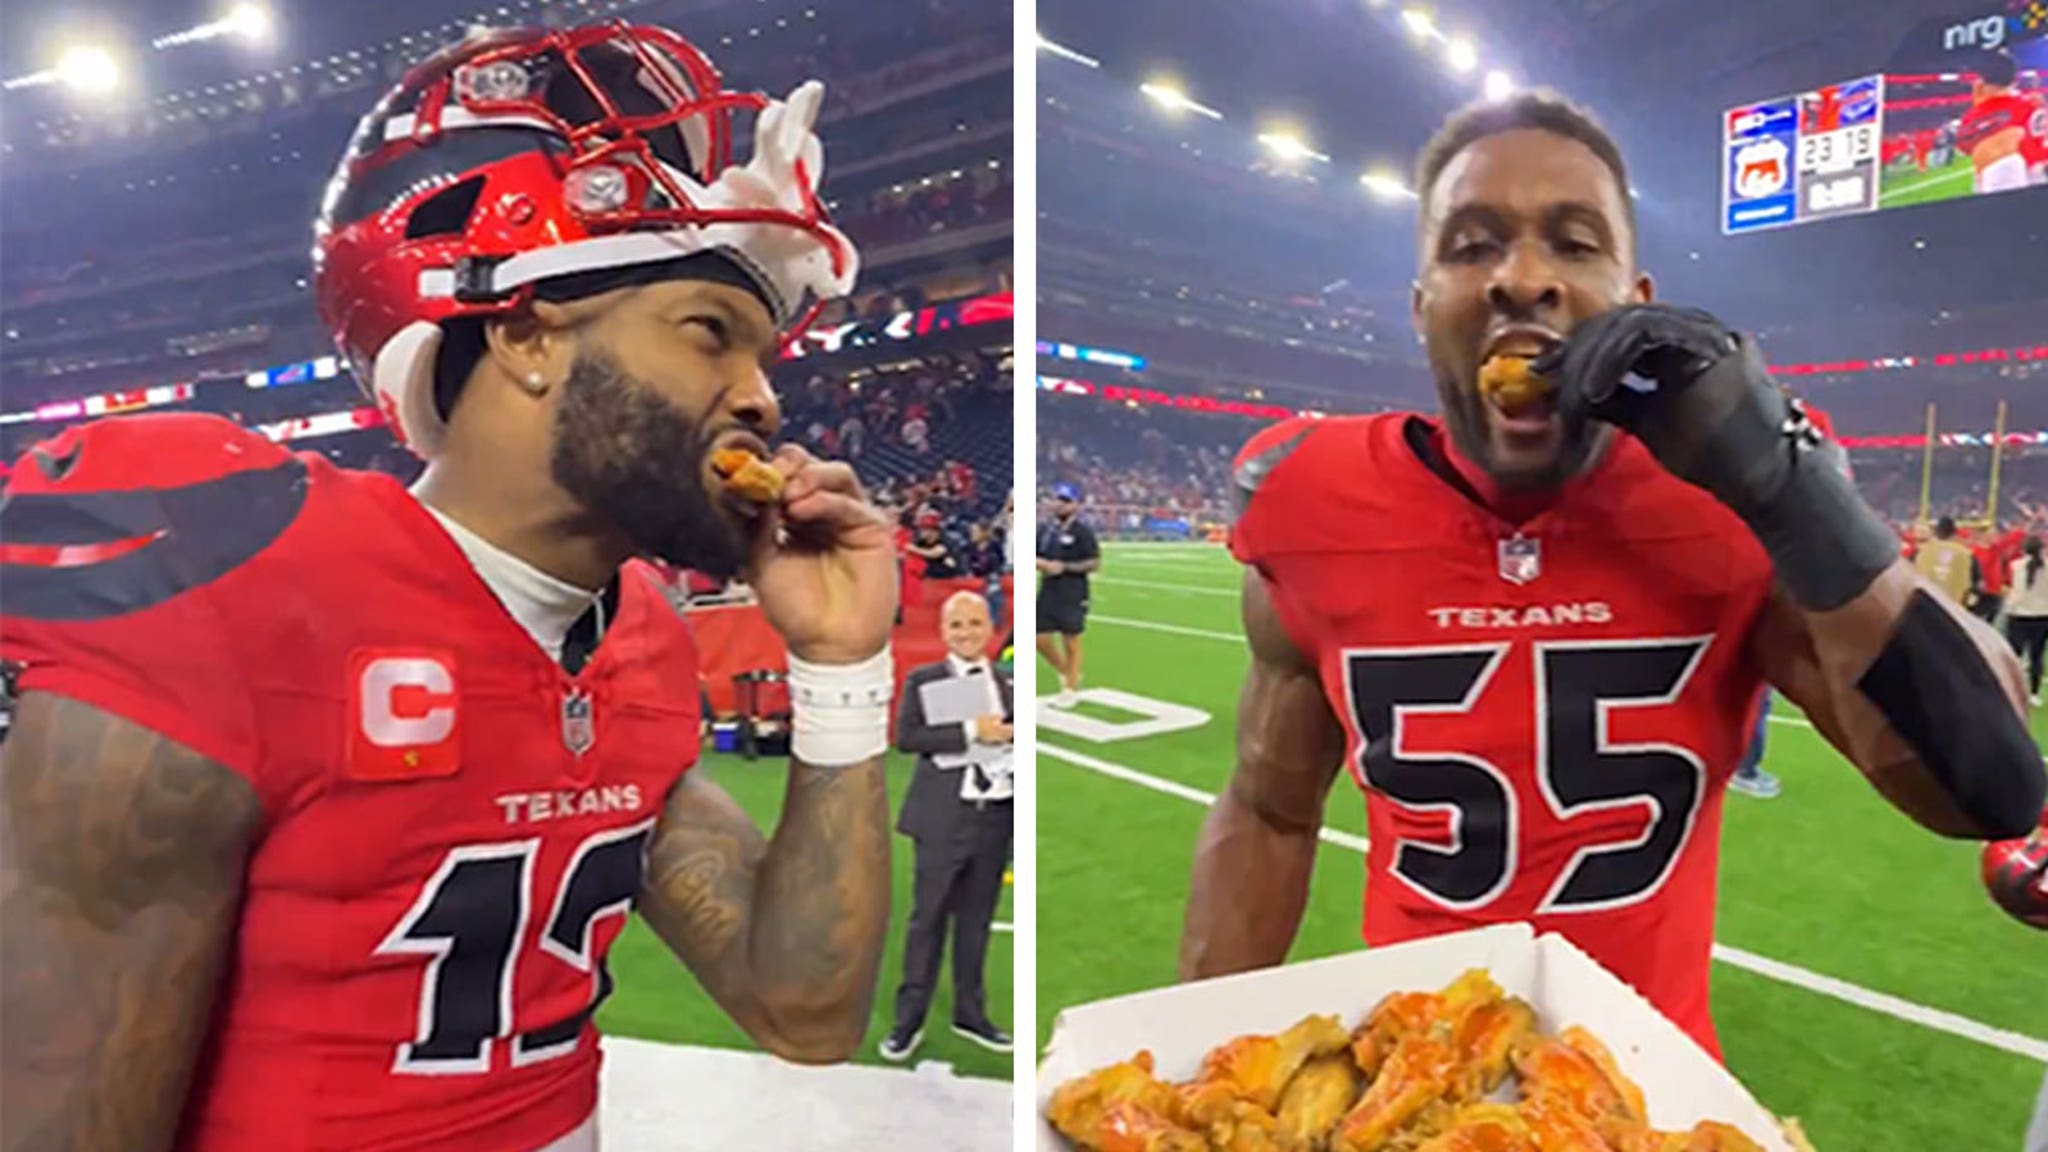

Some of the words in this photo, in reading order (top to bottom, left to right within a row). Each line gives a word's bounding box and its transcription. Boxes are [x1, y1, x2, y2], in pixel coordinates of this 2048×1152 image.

[1944, 15, 2004, 50] nrg
[1427, 602, 1612, 628] TEXANS
[361, 658, 454, 747] C
[1341, 633, 1716, 914] 55
[494, 783, 641, 825] TEXANS
